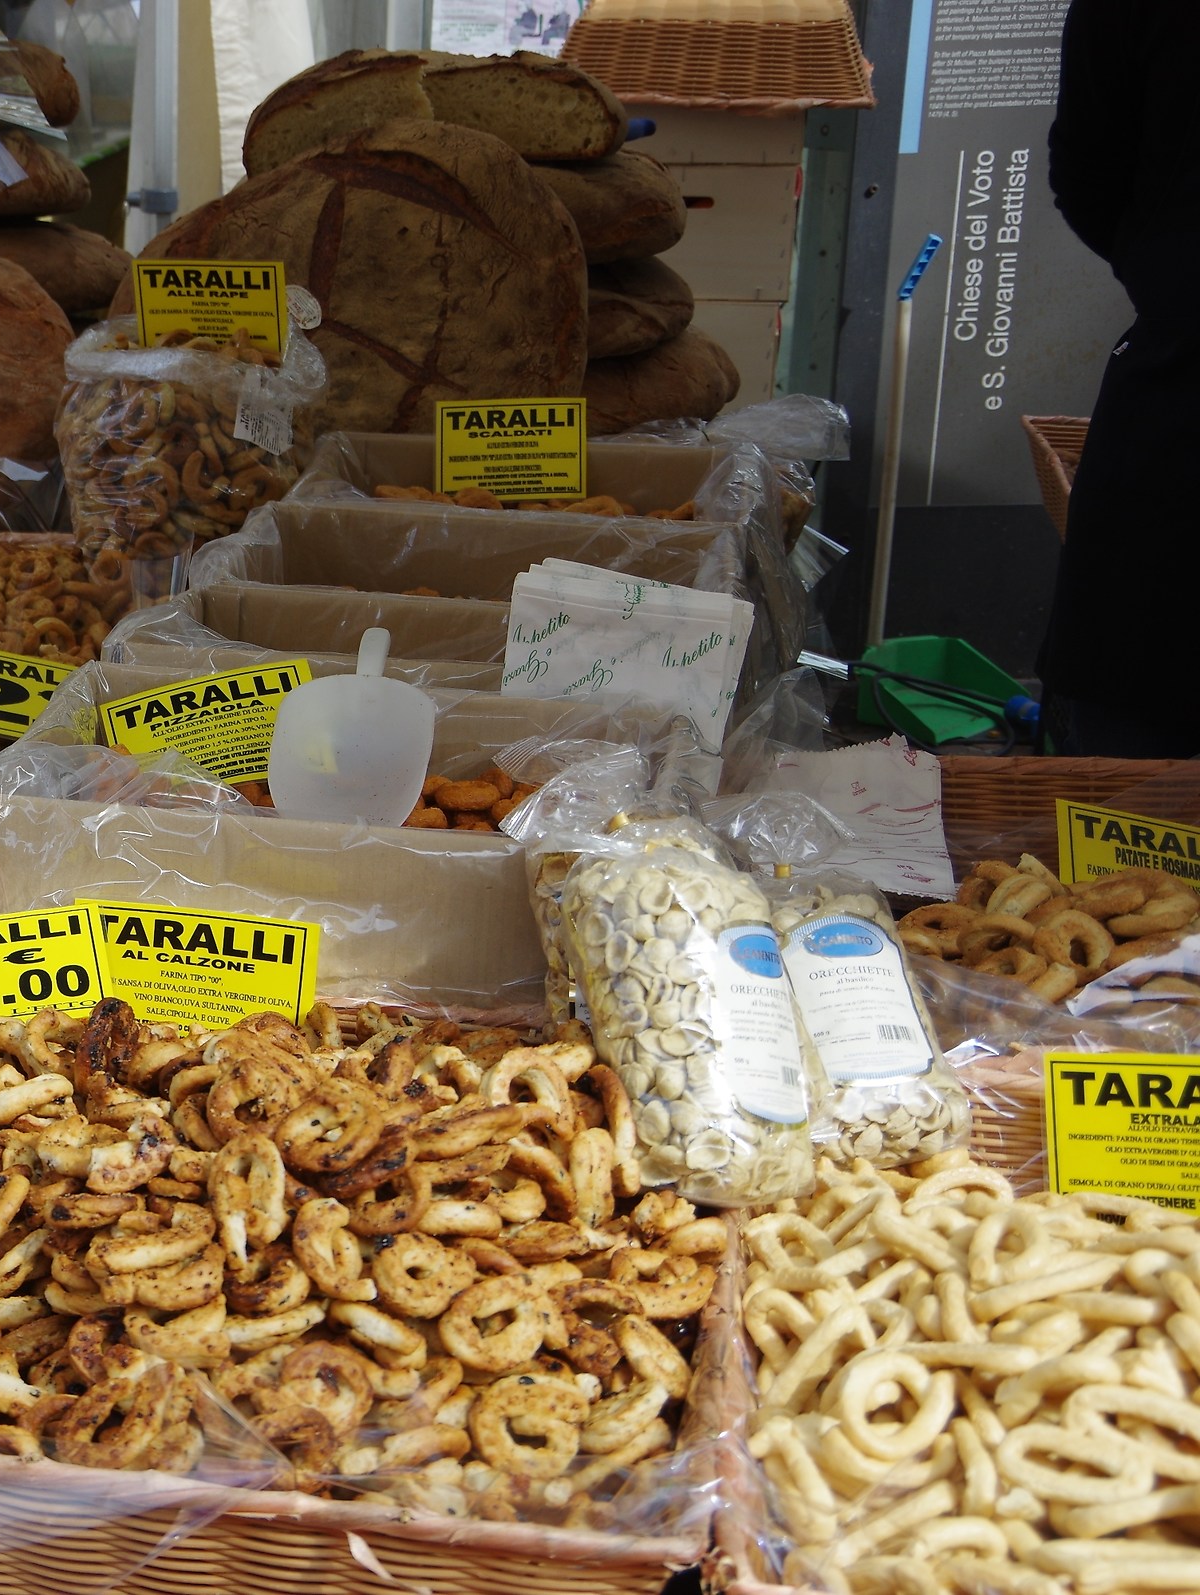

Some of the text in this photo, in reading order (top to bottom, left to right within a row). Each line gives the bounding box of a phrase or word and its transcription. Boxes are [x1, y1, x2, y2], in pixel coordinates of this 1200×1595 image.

[954, 150, 995, 341] Chiese del Voto
[143, 269, 270, 290] TARALLI
[982, 148, 1030, 410] e S. Giovanni Battista
[210, 291, 248, 299] RAPE
[446, 408, 574, 430] TARALLI
[468, 430, 552, 438] SCALDATI
[116, 672, 293, 729] TARALLI
[252, 706, 275, 715] OLIVA
[150, 699, 265, 732] PIZZAIOLA
[214, 720, 241, 731] FARINA
[243, 717, 258, 725] TIPO
[174, 736, 206, 749] VERGINE
[217, 729, 239, 739] OLIVA
[1075, 813, 1200, 861] TARAL
[1115, 846, 1150, 869] PATATE
[1153, 854, 1158, 869] E
[3, 948, 45, 964] €
[122, 949, 256, 974] AL CALZONE
[160, 970, 188, 980] FARINA
[190, 973, 207, 983] TIPO
[809, 966, 895, 980] ORECCHIETTE
[118, 978, 142, 987] SANSA
[144, 980, 152, 989] DI
[198, 986, 222, 998] EXTRA
[224, 990, 256, 1003] VERGINE
[258, 995, 266, 1005] DI
[134, 993, 153, 1002] VINO
[1069, 1179, 1102, 1187] SEMOLA
[1115, 1180, 1144, 1189] GRANO
